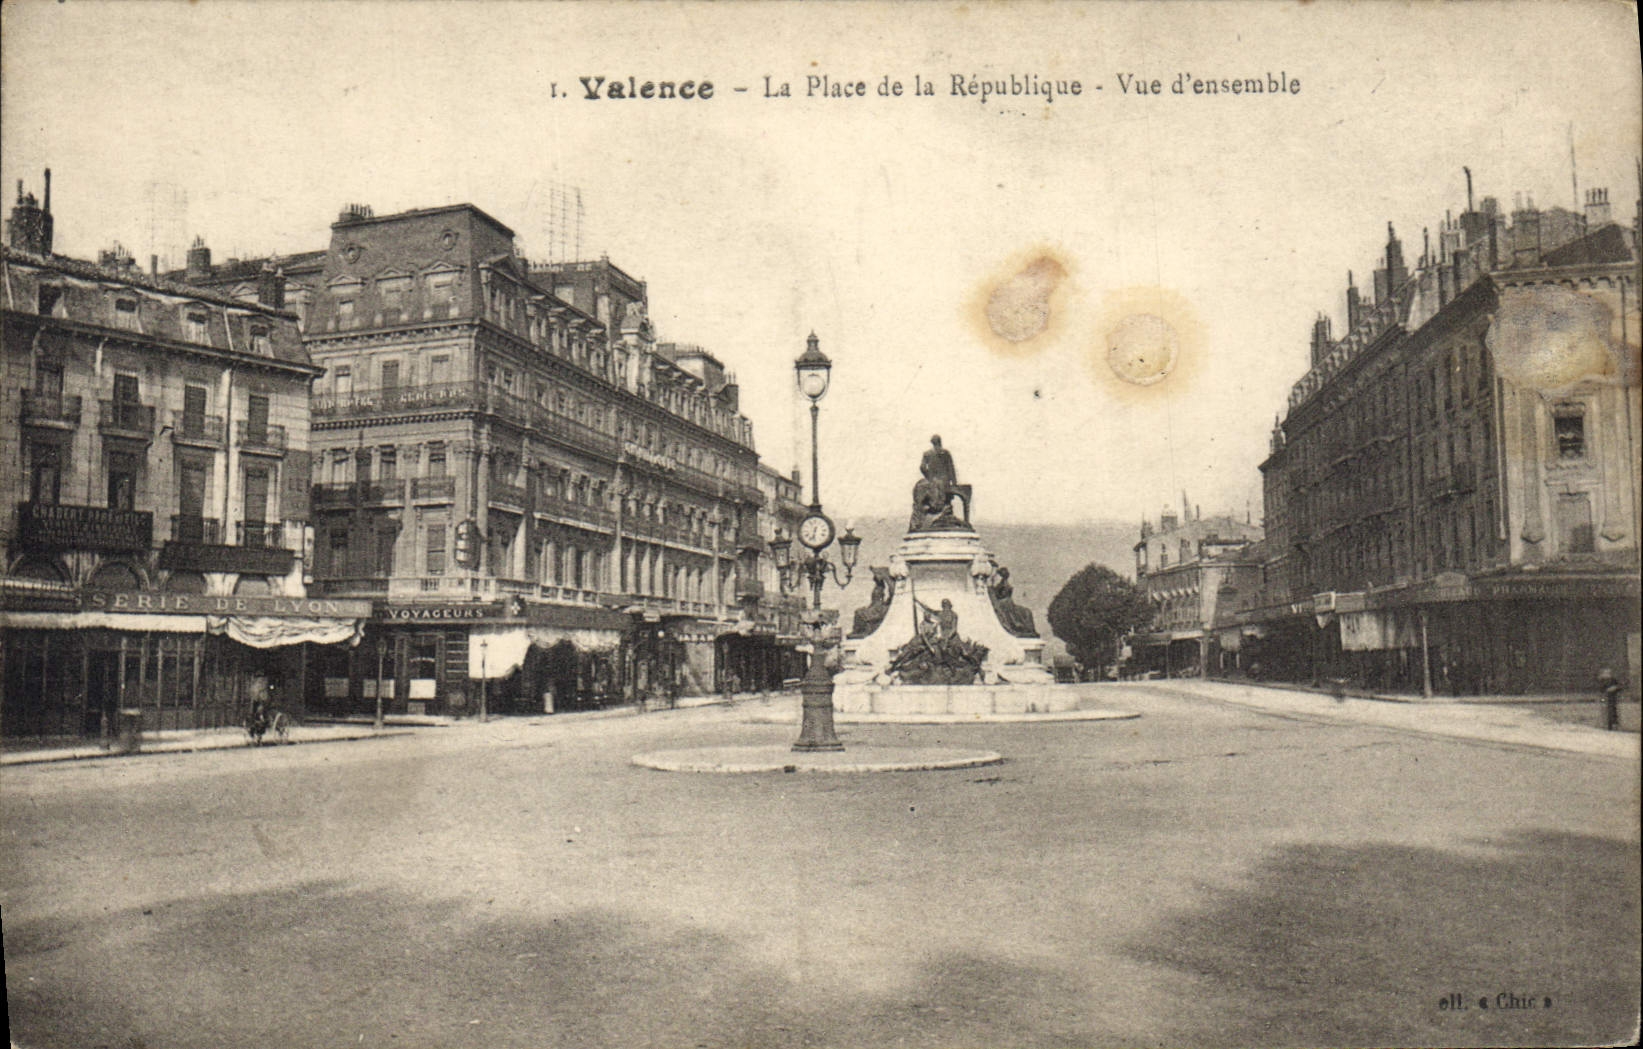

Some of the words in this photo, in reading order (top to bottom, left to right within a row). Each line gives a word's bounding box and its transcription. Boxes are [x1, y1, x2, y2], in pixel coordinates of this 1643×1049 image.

[214, 597, 247, 611] DE
[274, 598, 339, 614] LYON
[387, 607, 484, 620] VOYAGEURS
